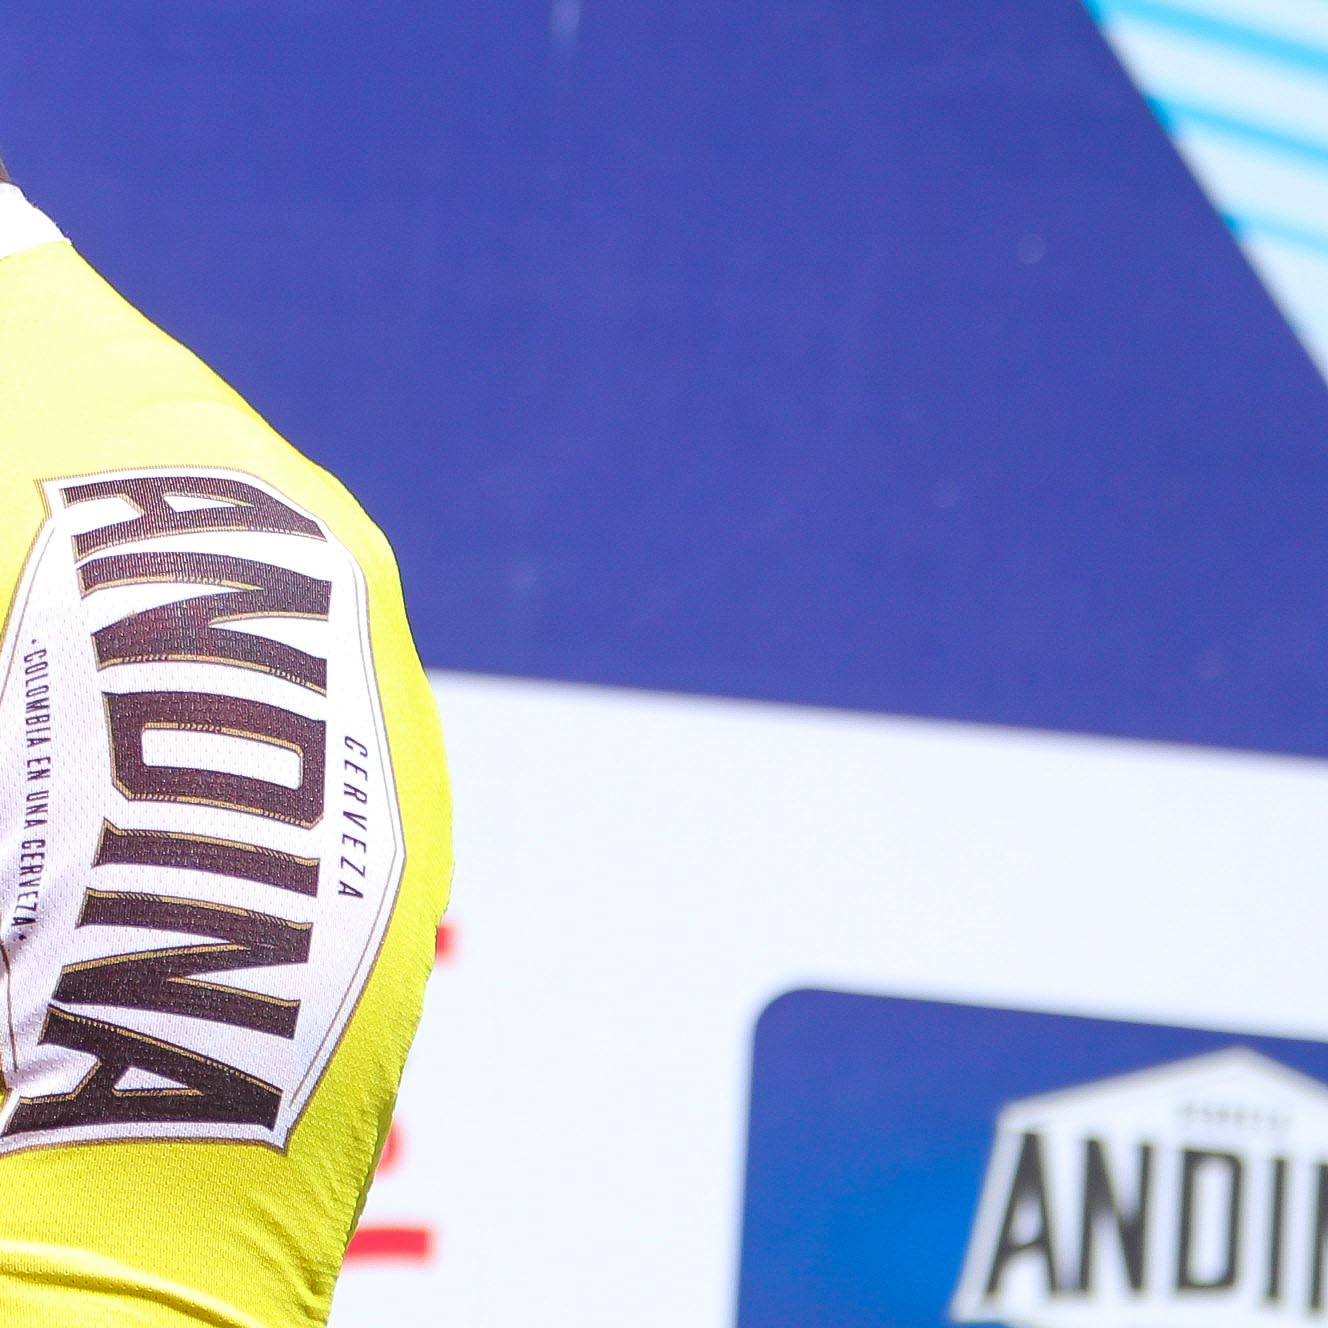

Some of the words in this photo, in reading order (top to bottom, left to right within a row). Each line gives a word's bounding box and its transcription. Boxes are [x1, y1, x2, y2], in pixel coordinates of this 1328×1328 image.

[0, 476, 334, 1138] ANDINA
[24, 790, 50, 830] UNA
[26, 756, 52, 782] EN
[338, 735, 369, 900] CERVEZA
[984, 1128, 1328, 1314] ANDI
